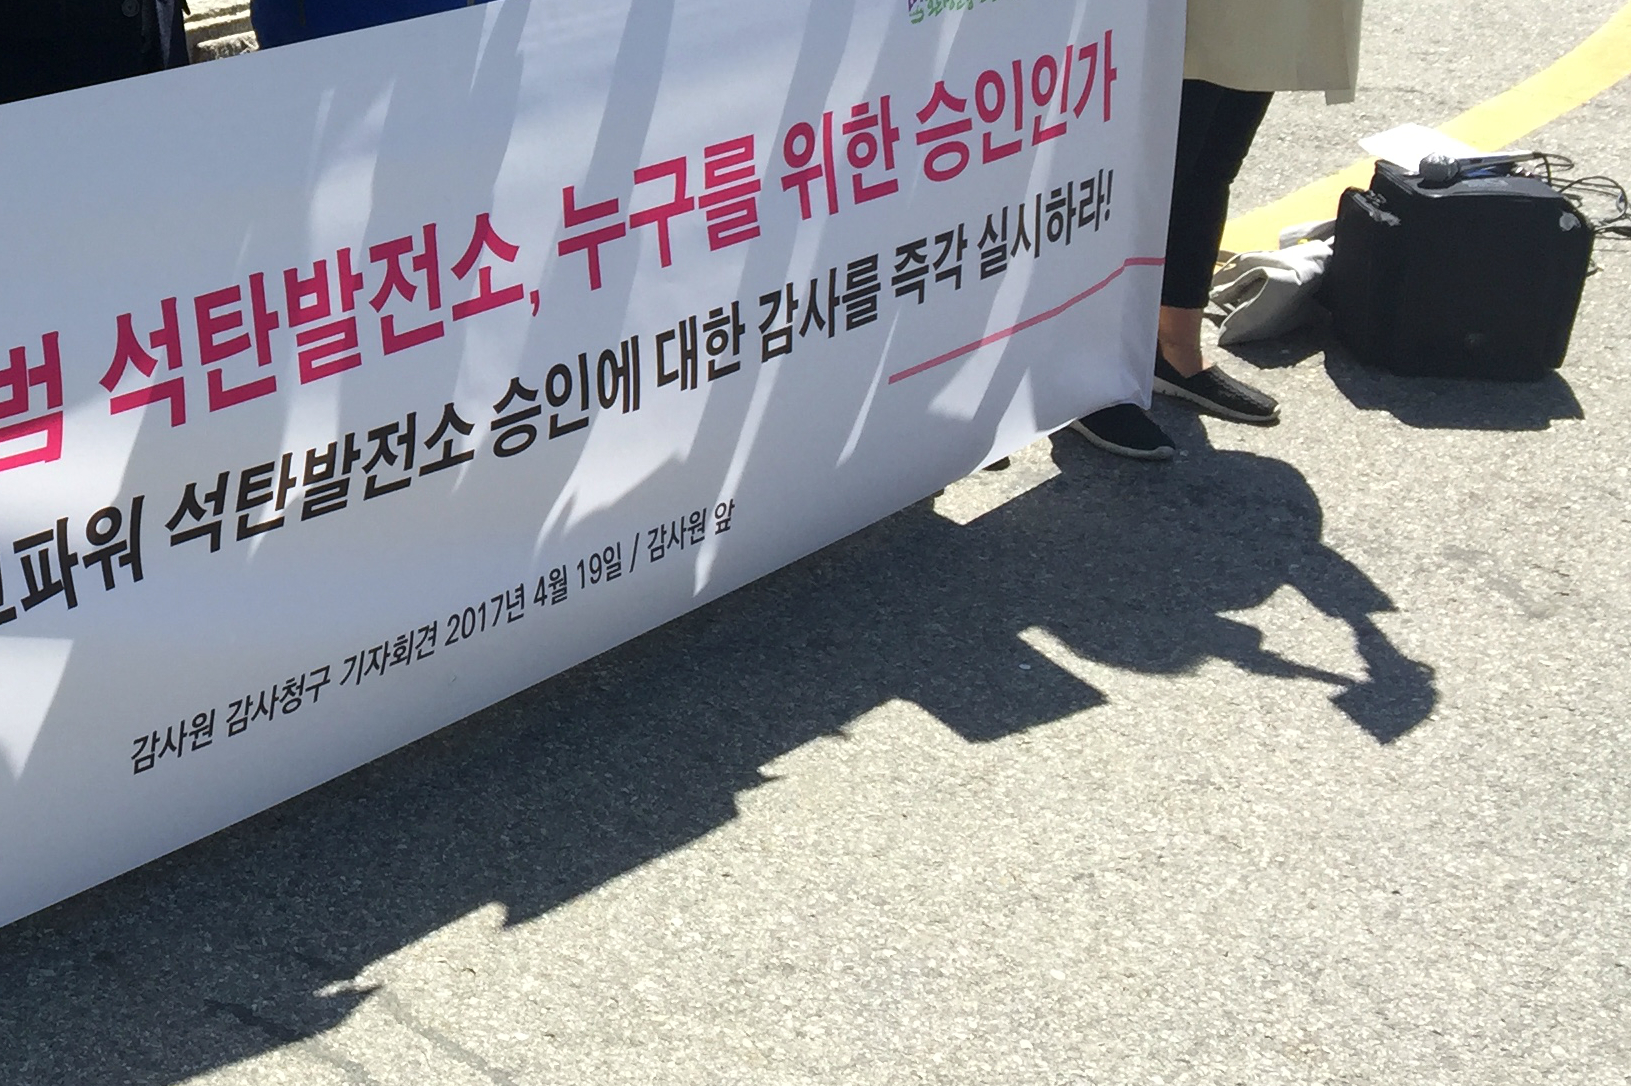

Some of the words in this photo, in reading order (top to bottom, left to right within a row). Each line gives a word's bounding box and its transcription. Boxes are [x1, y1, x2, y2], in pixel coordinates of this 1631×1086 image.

[99, 213, 541, 426] 석탄발전소,
[558, 135, 761, 290] 누구를
[781, 101, 900, 219] 위한
[916, 30, 1116, 182] 승인인가
[164, 403, 474, 553] 석탄발전소
[491, 351, 640, 457] 승인에
[656, 302, 741, 391] 대한
[758, 253, 881, 355] 감사를
[892, 223, 967, 304] 즉각
[977, 169, 1113, 280] 실시하라!
[131, 709, 215, 775] 감사원
[226, 665, 330, 737] 감사청구
[340, 621, 437, 685] 기자회견
[445, 583, 524, 646] 2017년
[534, 565, 567, 606] 4월
[577, 542, 621, 589] 19일
[630, 533, 639, 573] /
[648, 508, 706, 562] 감사원
[715, 499, 735, 534] 앞
